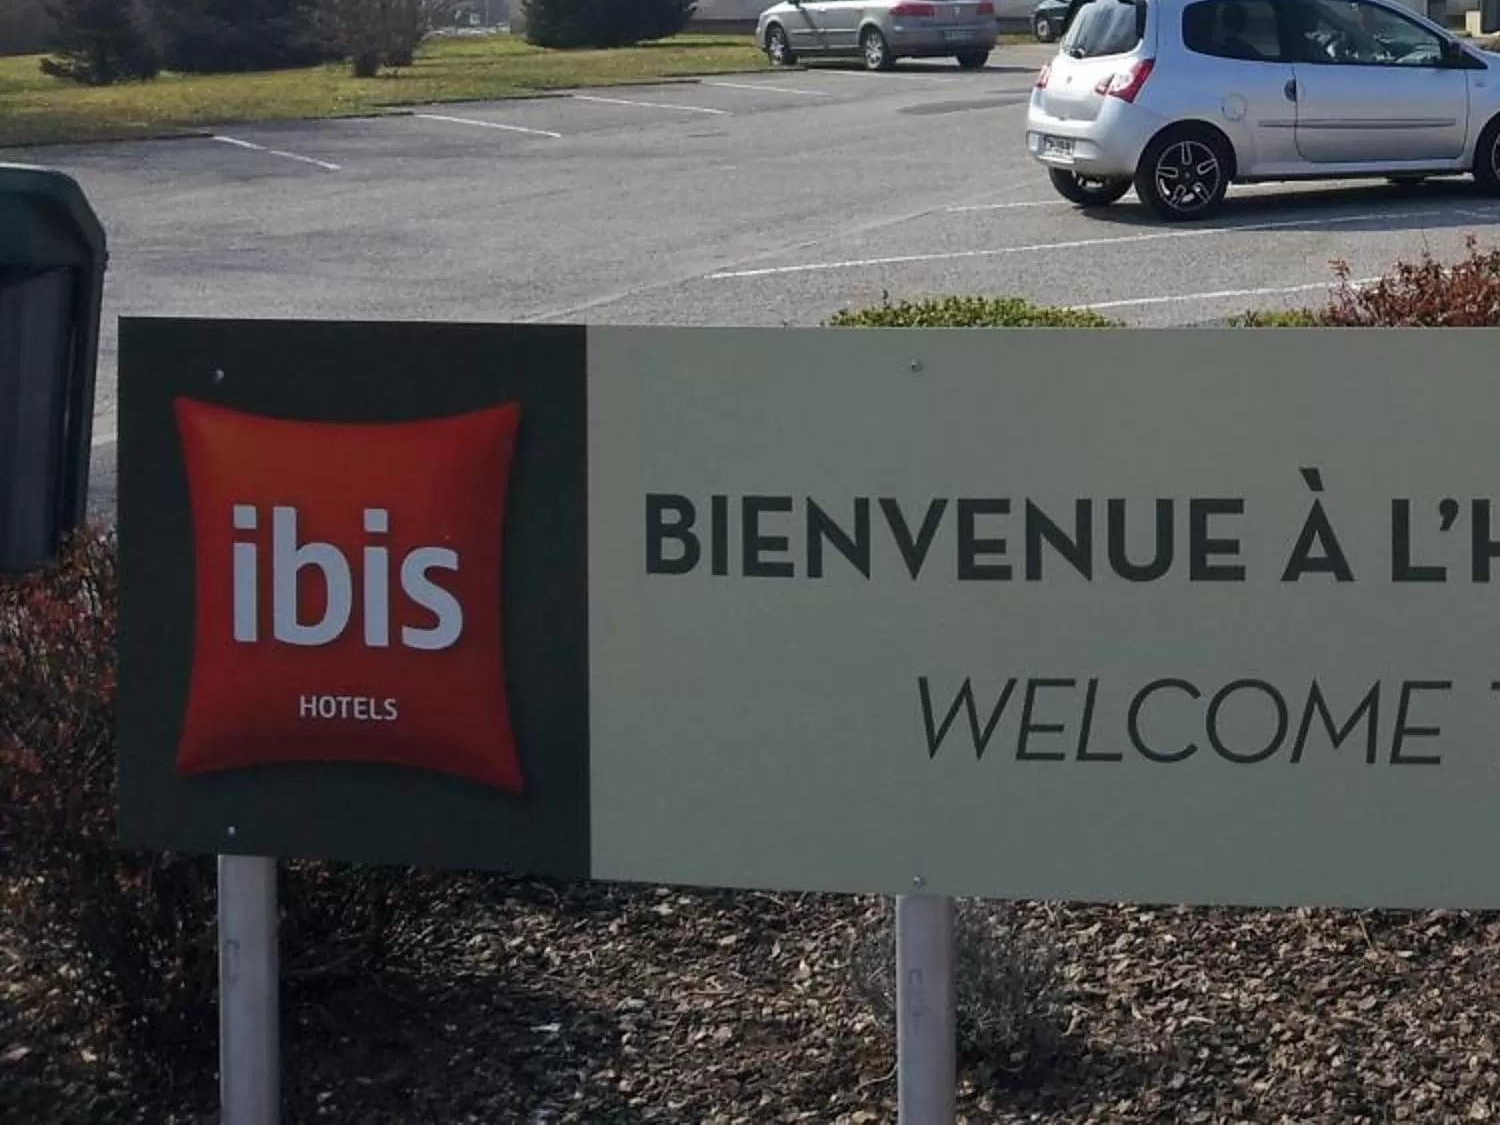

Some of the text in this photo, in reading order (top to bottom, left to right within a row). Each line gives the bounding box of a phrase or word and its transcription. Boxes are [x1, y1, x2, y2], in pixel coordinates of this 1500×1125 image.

[645, 492, 1247, 583] BIENVENUE
[1279, 466, 1356, 583] À
[233, 505, 464, 650] ibis
[299, 694, 399, 721] HOTELS
[917, 676, 1454, 766] WELCOME
